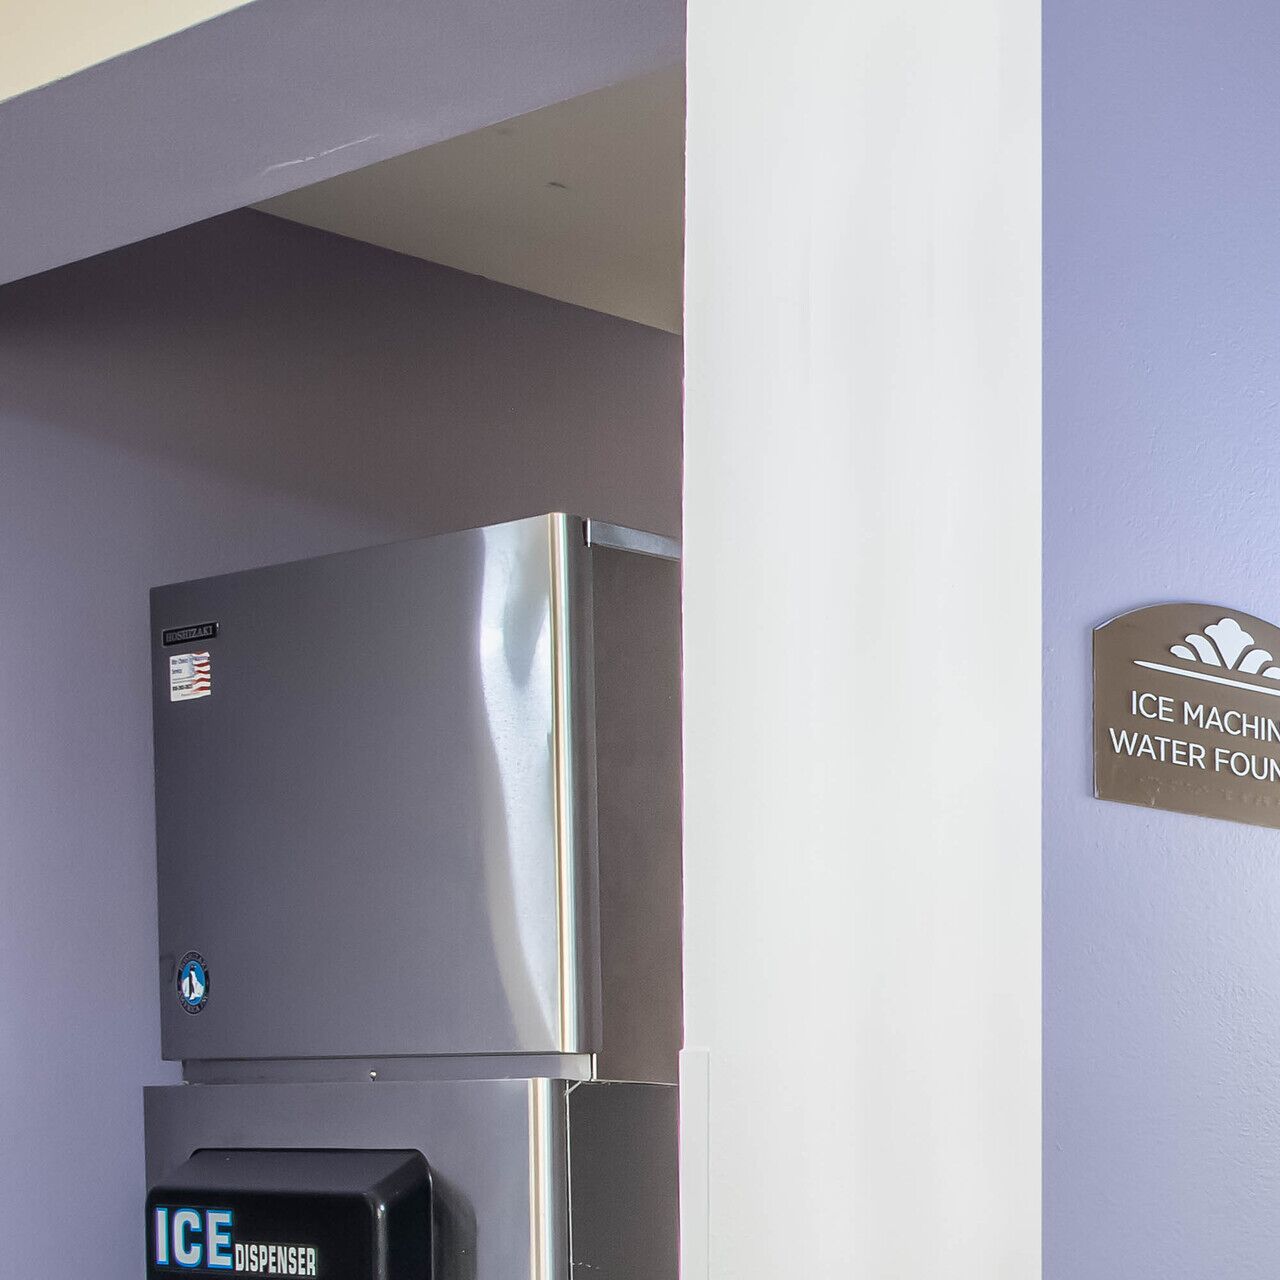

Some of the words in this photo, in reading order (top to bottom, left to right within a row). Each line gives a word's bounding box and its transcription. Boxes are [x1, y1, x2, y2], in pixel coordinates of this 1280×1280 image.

[1131, 690, 1174, 723] ICE
[1109, 727, 1206, 770] WATER
[155, 1206, 234, 1270] ICE
[234, 1243, 317, 1277] DISPENSER
